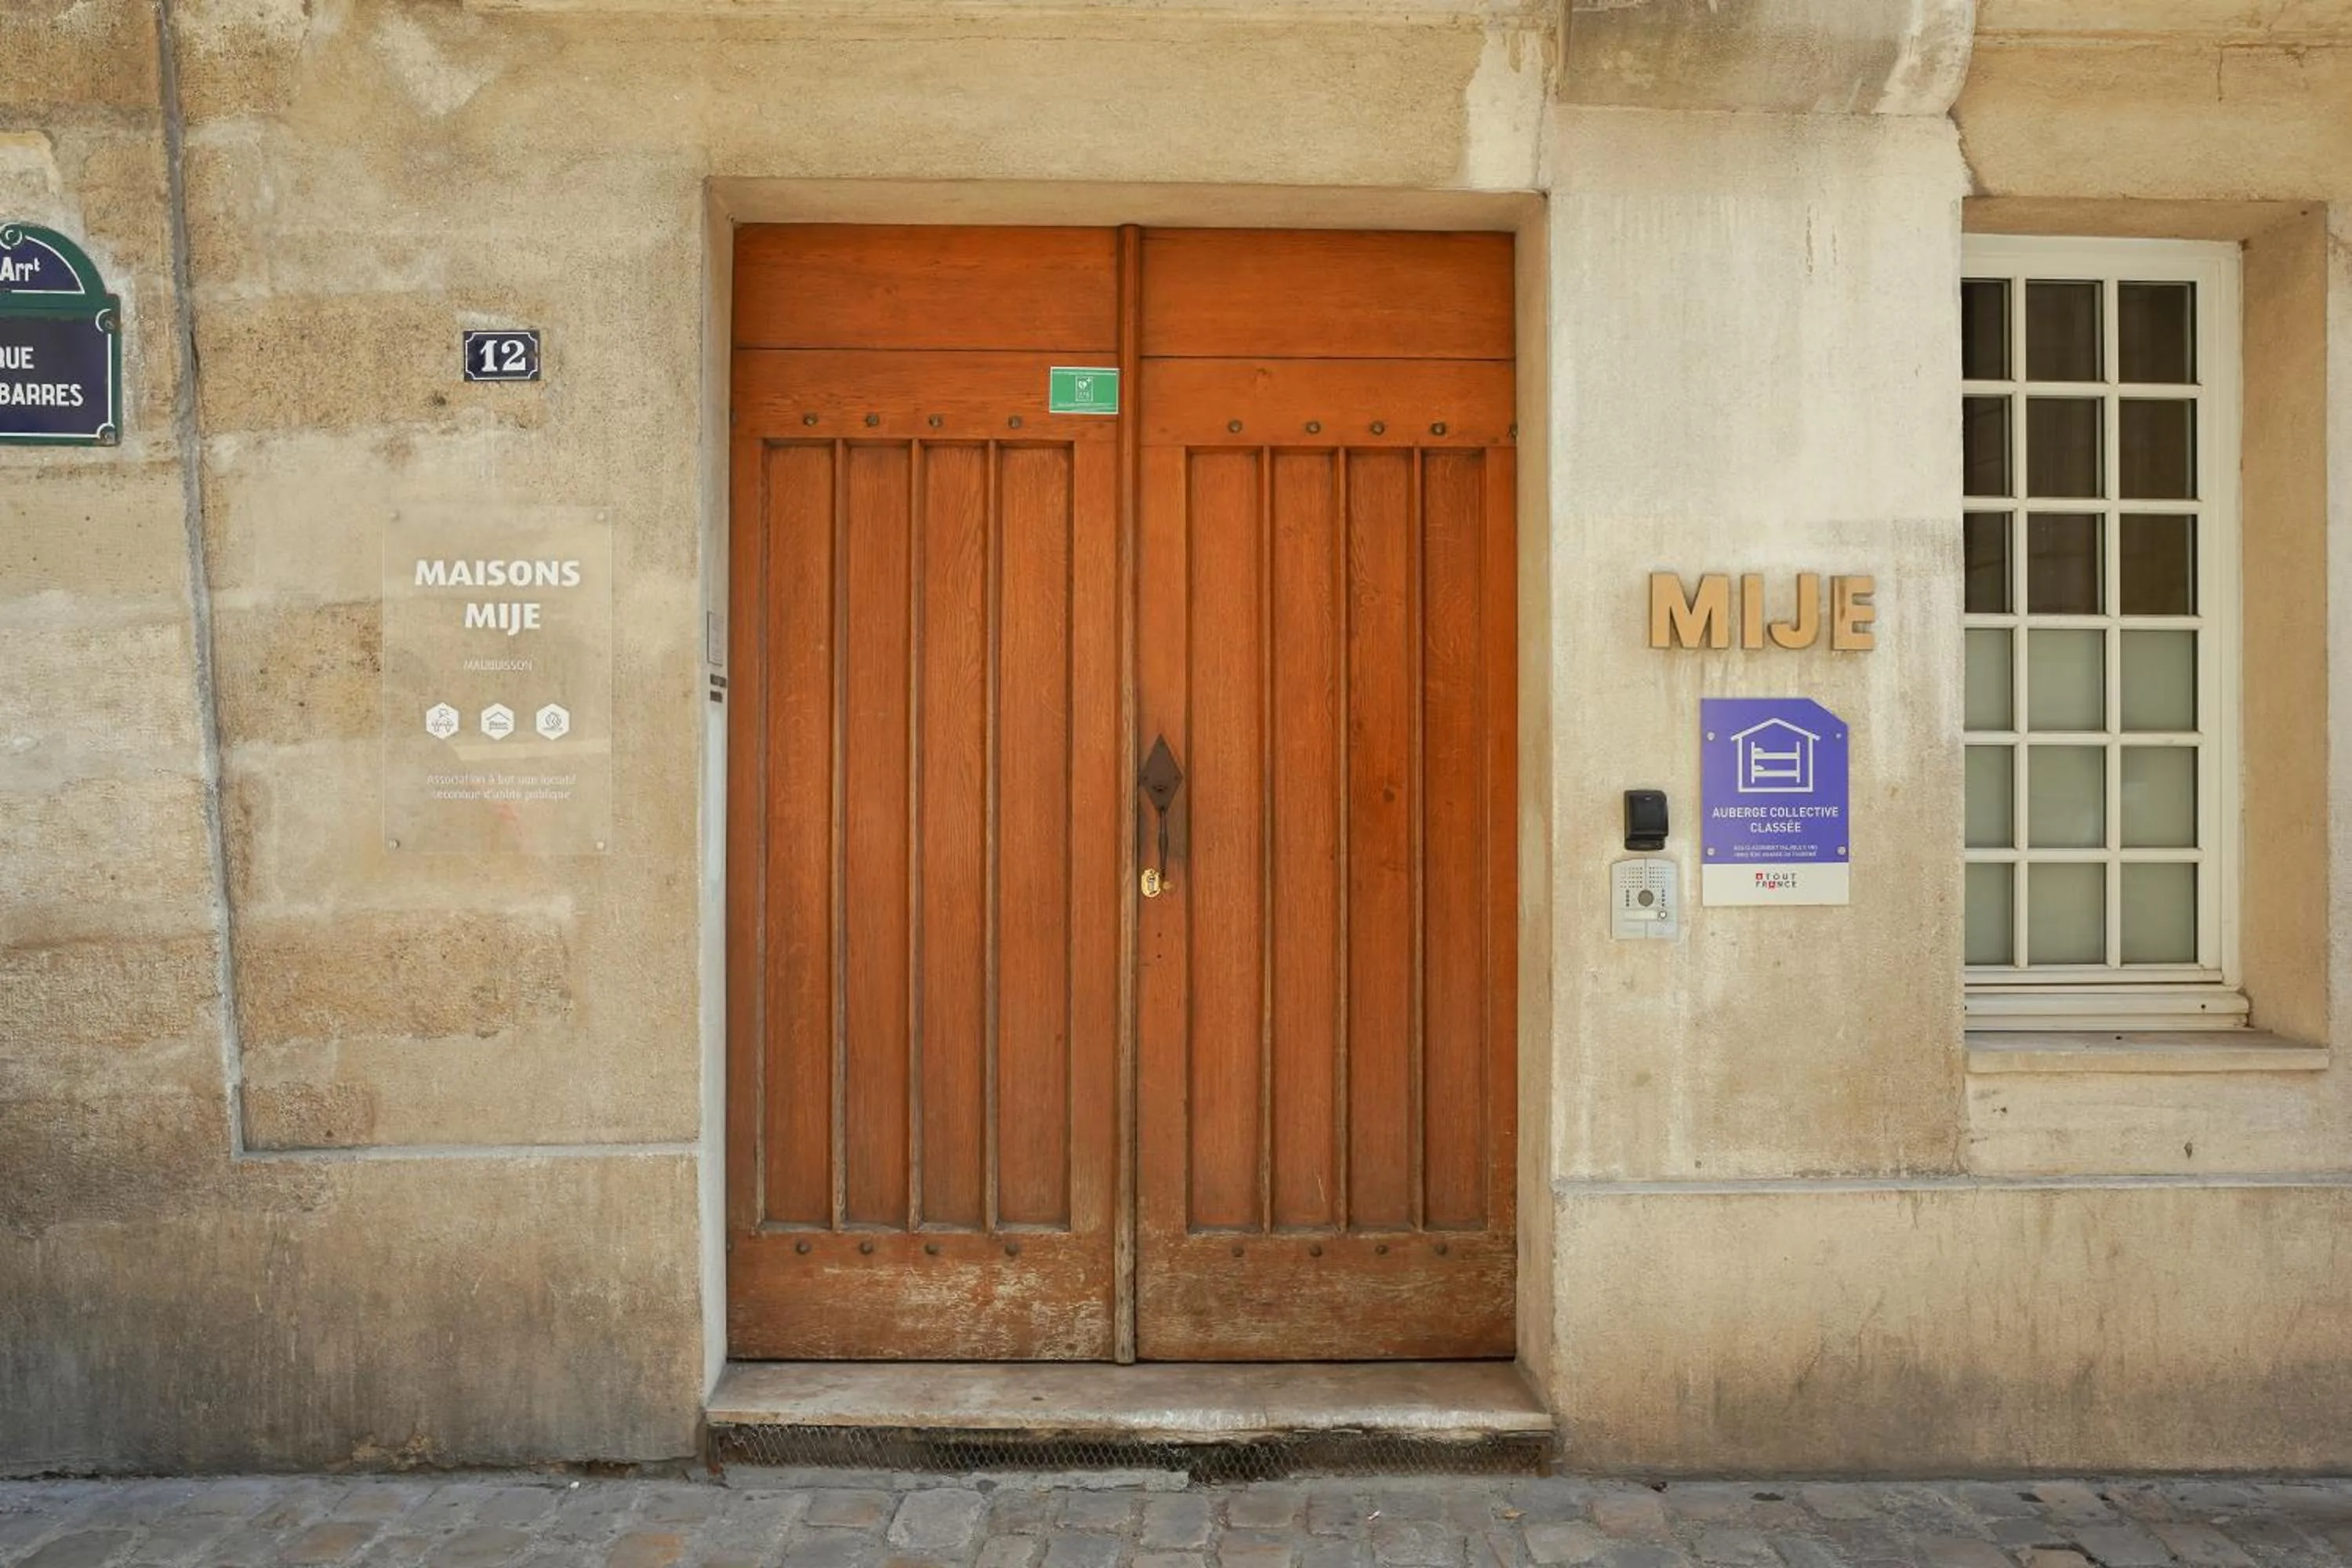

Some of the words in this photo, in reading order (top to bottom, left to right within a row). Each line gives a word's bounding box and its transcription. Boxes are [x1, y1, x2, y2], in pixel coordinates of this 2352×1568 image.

[480, 339, 526, 372] 12
[0, 383, 84, 407] BARRES
[415, 560, 580, 586] MAISONS
[465, 602, 541, 636] MIJE
[1649, 572, 1875, 651] MIJE
[1712, 806, 1767, 818] AUBERGE
[1769, 806, 1839, 818] COLLECTIVE
[1750, 819, 1802, 833] CLASSÉE
